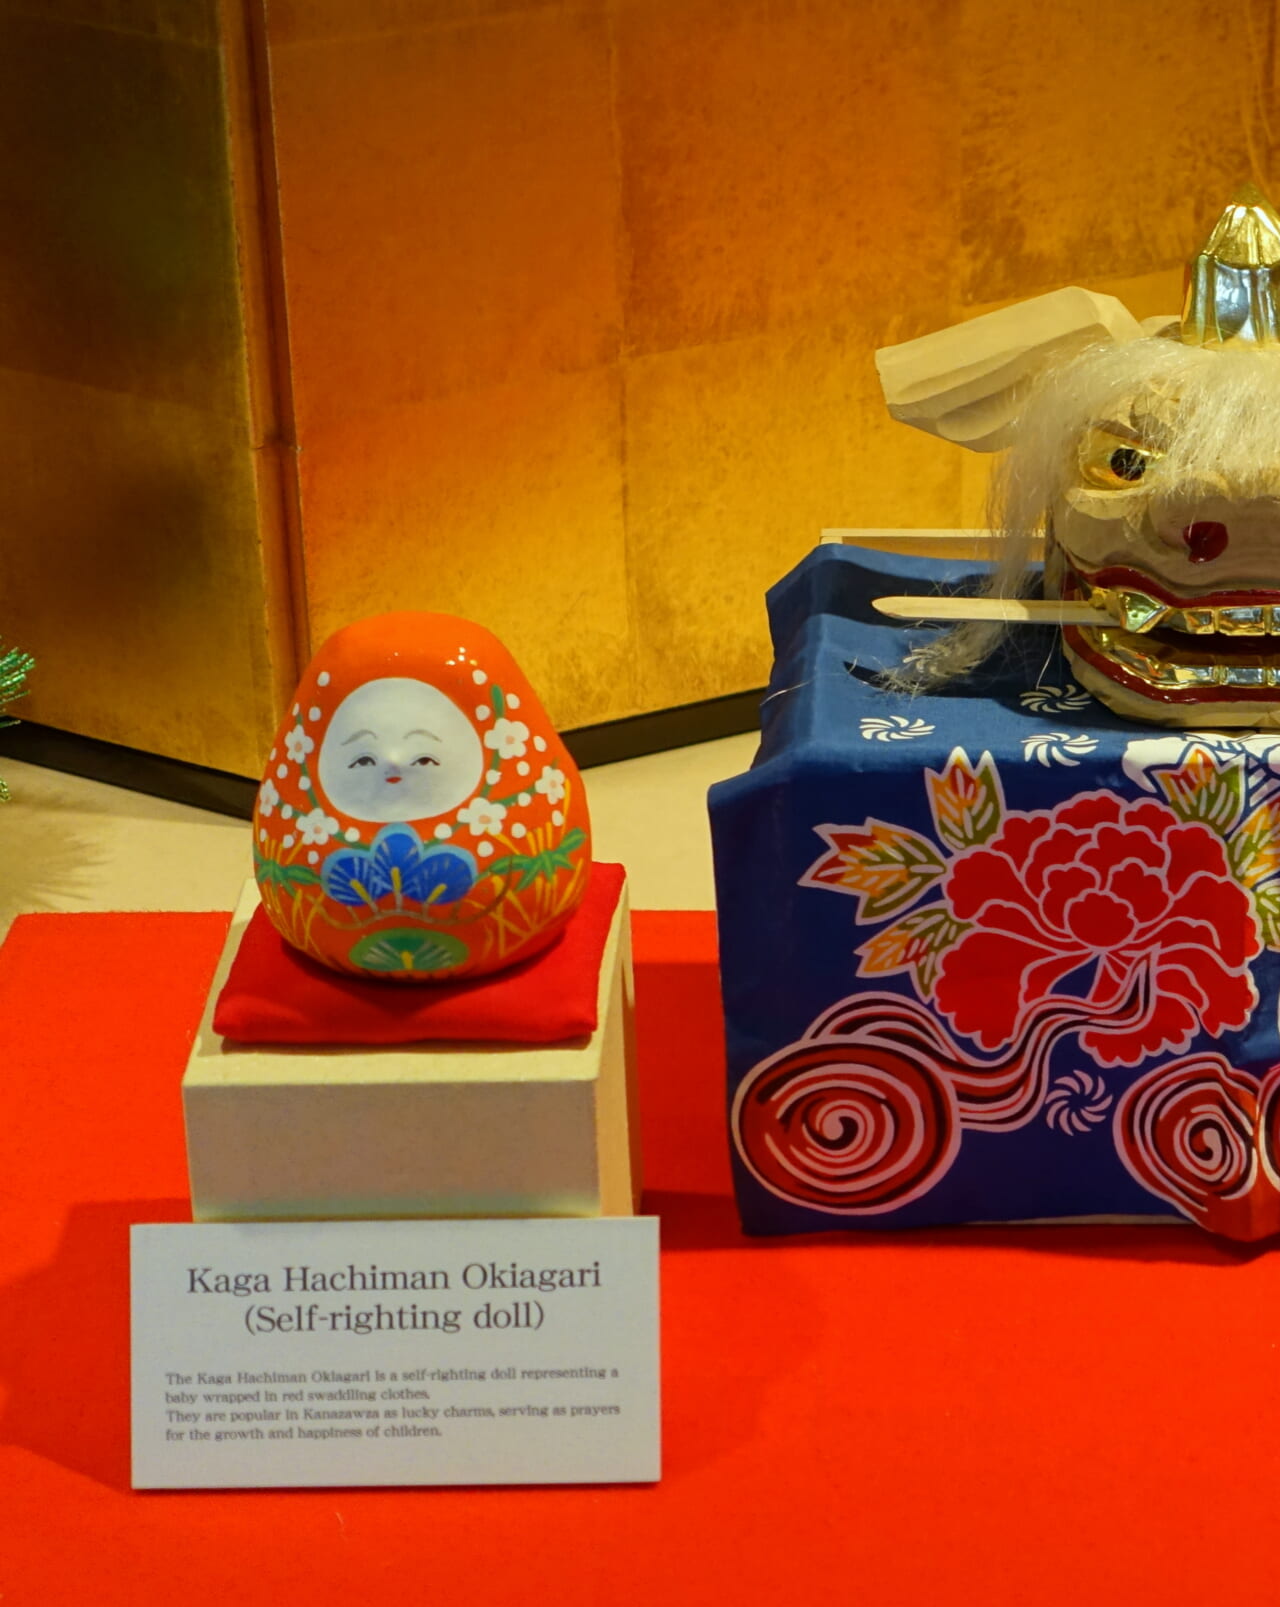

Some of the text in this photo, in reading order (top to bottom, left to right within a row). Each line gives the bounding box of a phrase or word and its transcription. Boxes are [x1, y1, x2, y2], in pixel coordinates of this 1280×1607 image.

[186, 1261, 602, 1294] Kaga Hachiman Okiagari
[244, 1301, 544, 1335] (Self-righting doll)
[165, 1368, 618, 1385] The Kaga Hachiman Okiagari is a self-righting doll representing a
[165, 1388, 430, 1404] baby wrapped in red swaddling clothes.
[165, 1410, 199, 1423] They
[205, 1412, 226, 1422] are
[230, 1410, 280, 1422] popular
[286, 1409, 298, 1420] in
[384, 1409, 397, 1418] as
[402, 1406, 438, 1419] lucky
[444, 1406, 494, 1418] charms,
[499, 1405, 547, 1417] serving
[553, 1406, 566, 1415] as
[571, 1405, 620, 1417] prayers
[165, 1425, 442, 1441] for the growth and happiness of children.
